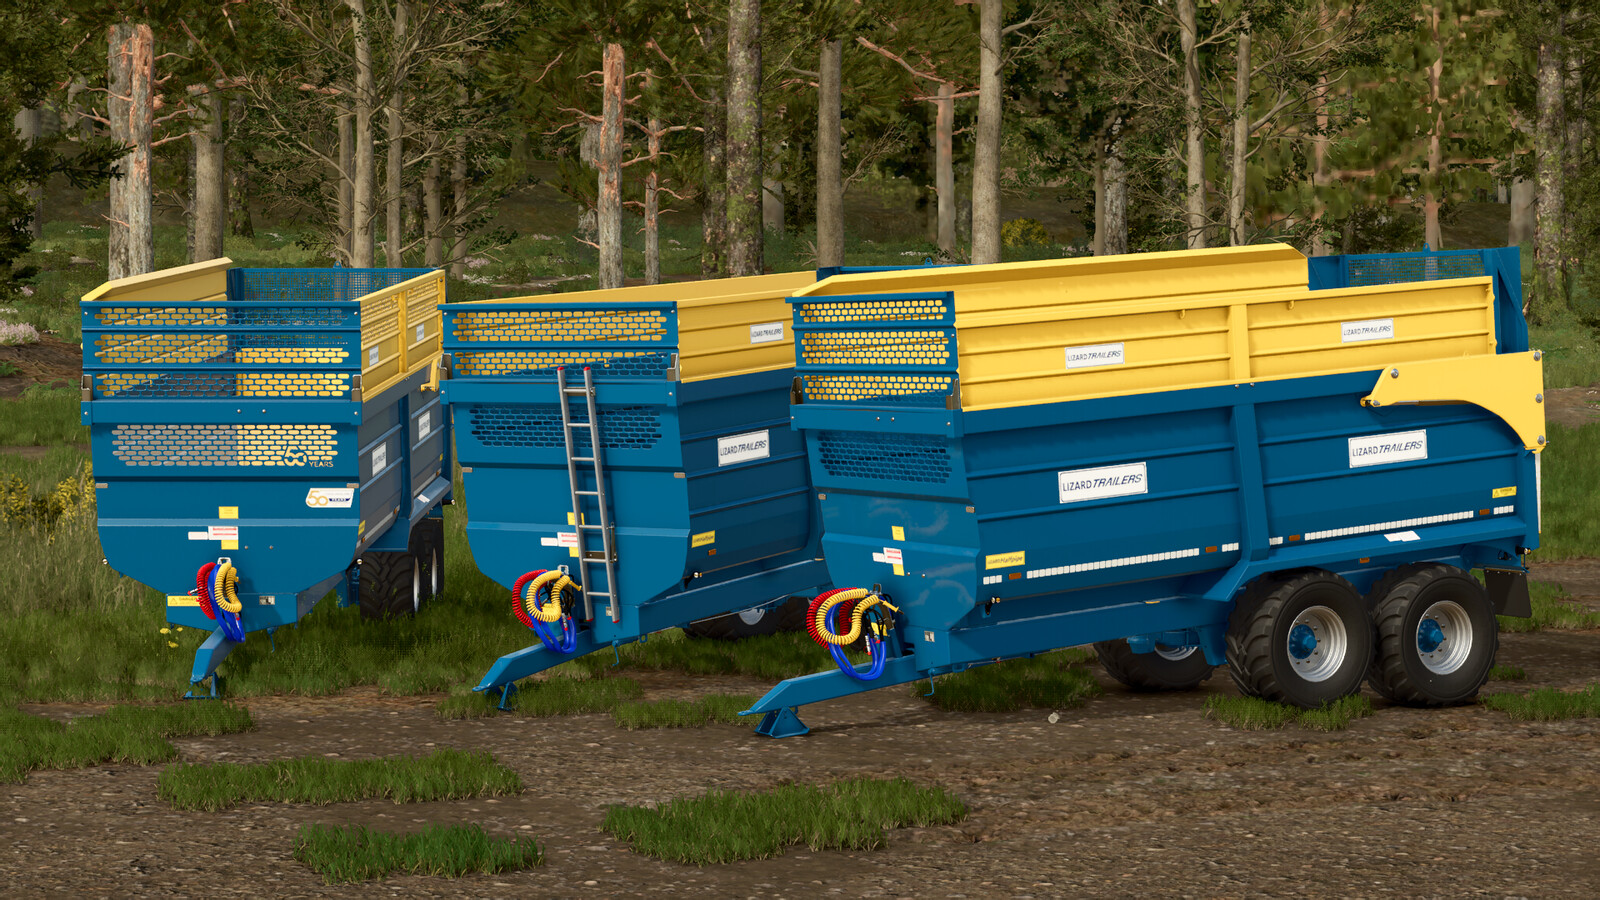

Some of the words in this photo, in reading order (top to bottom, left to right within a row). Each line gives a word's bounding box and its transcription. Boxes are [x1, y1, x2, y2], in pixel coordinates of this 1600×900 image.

[1088, 350, 1122, 360] TRAILERS
[720, 445, 738, 457] LIZARD
[738, 439, 767, 453] TRAILERS
[1352, 446, 1379, 457] LIZARD
[1379, 440, 1423, 454] TRAILERS
[309, 460, 334, 468] YEARS
[1062, 479, 1092, 492] LIZARD
[1093, 473, 1143, 488] TRAILERS
[307, 490, 329, 506] 50
